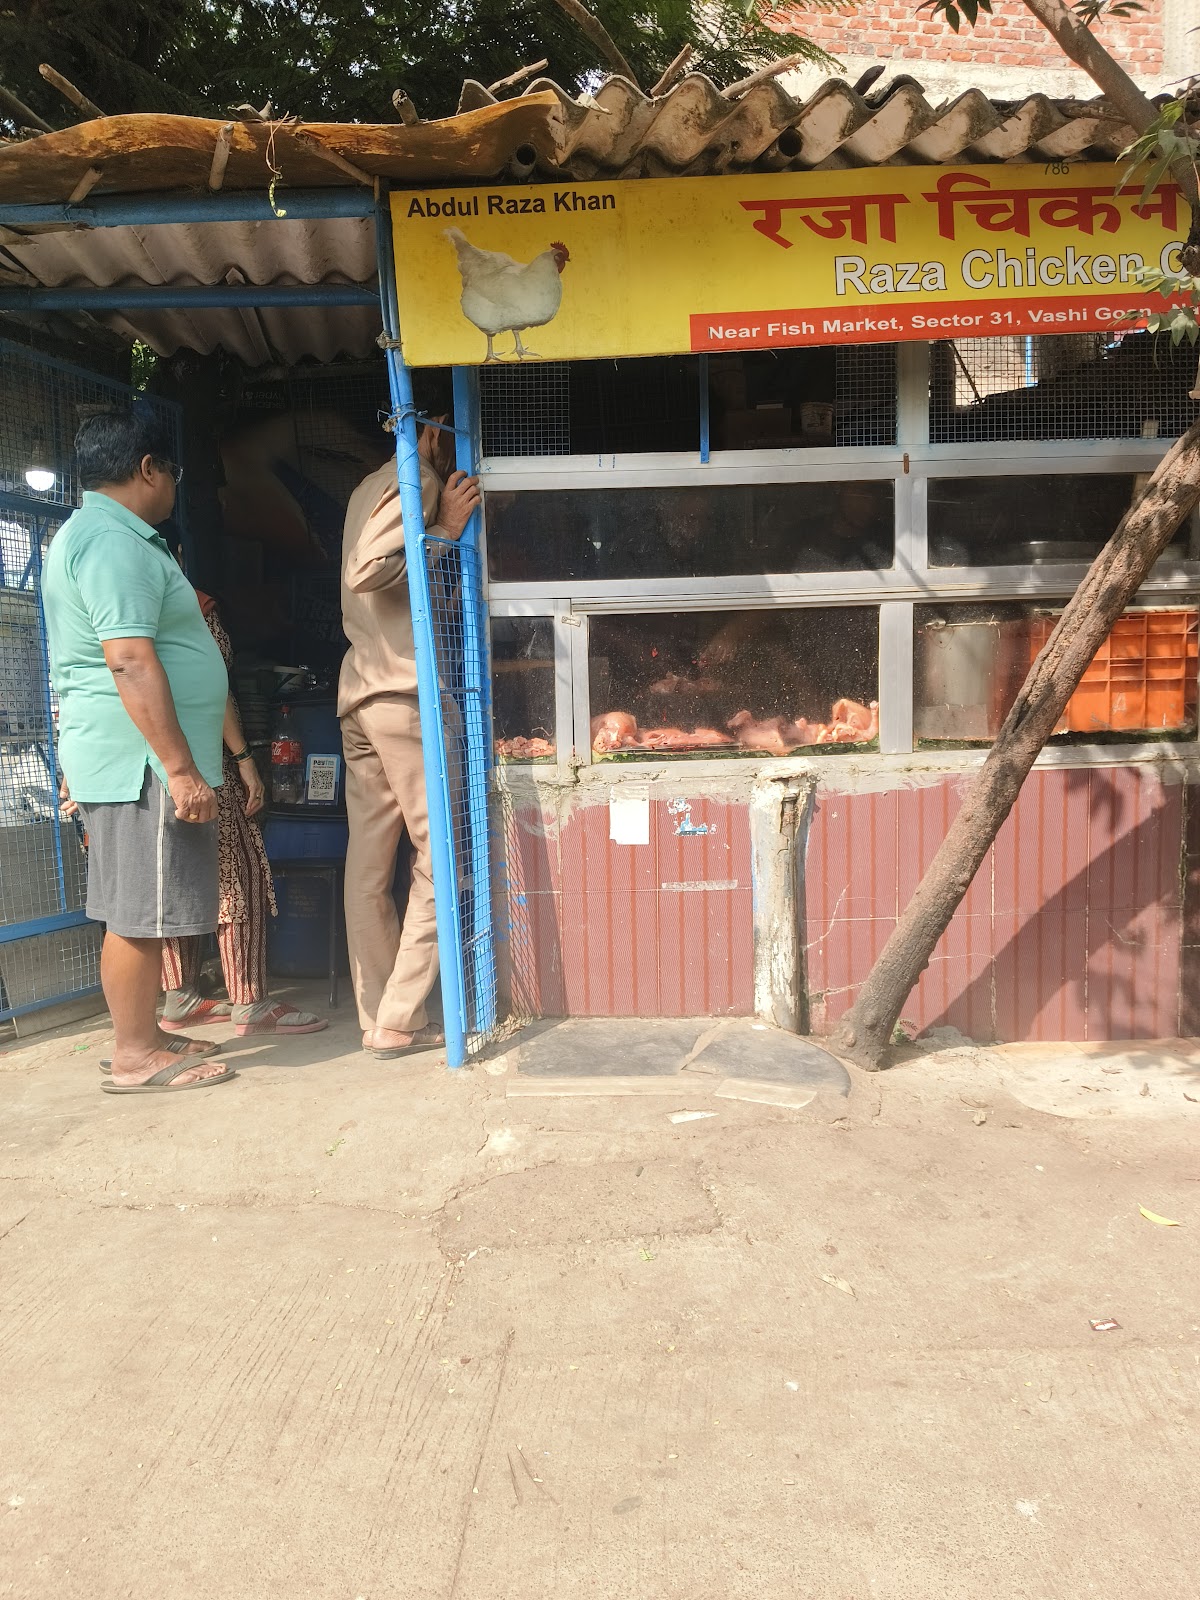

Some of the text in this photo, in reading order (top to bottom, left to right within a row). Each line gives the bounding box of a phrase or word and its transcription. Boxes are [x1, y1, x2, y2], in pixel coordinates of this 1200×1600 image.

[1045, 162, 1070, 175] 786
[407, 191, 616, 218] Abdul Raza Khan
[738, 172, 1185, 250] रजा चिकन
[834, 240, 1190, 296] Raza Chicken C
[709, 326, 760, 340] Near
[767, 322, 815, 337] Fish
[823, 317, 904, 333] Market,
[911, 314, 983, 329] Sector
[990, 311, 1021, 326] 31,
[1028, 308, 1088, 323] Vashi
